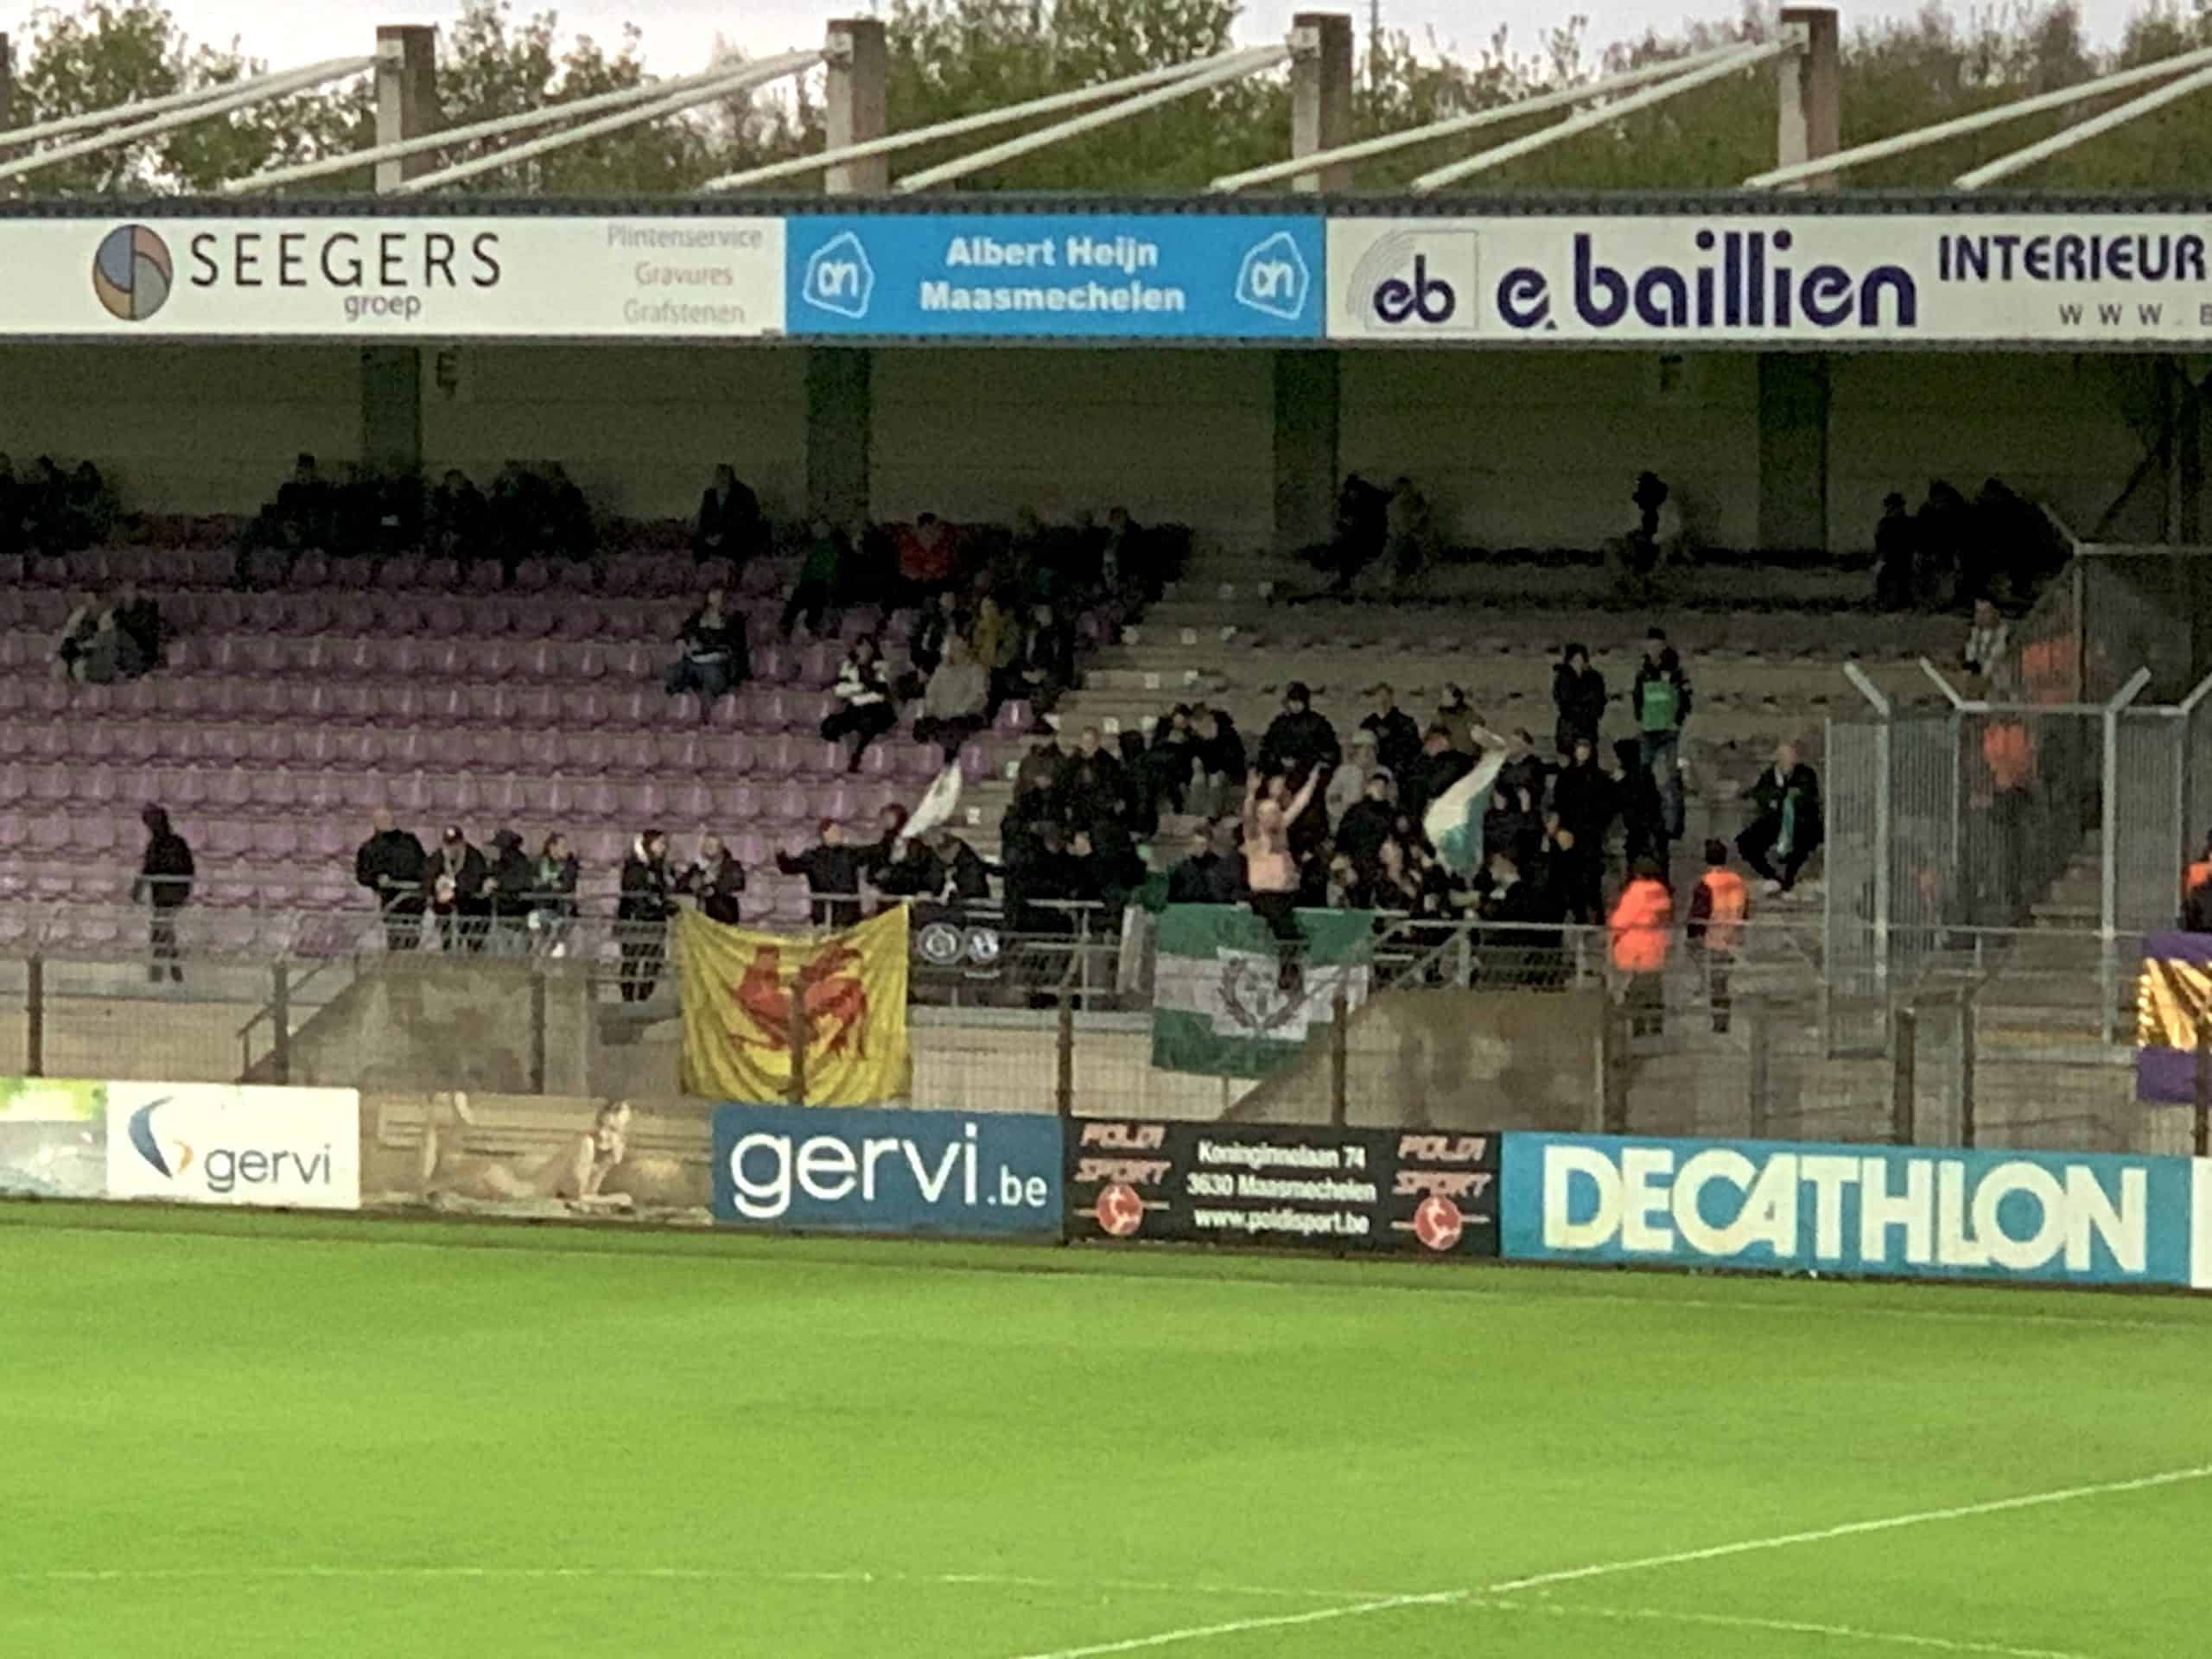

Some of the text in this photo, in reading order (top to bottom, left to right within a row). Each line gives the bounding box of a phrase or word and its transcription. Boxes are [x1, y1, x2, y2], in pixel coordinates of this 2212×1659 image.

[607, 224, 762, 250] Plintenservice
[189, 232, 501, 288] SEEGERS
[946, 236, 1158, 274] Albert Heijn
[1938, 234, 2206, 282] INTERIEUR
[634, 261, 734, 287] Gravures
[1373, 253, 1456, 324] eb
[344, 295, 423, 322] groep
[623, 298, 746, 325] Grafstenen
[919, 281, 1185, 313] Maasmechelen
[203, 1141, 332, 1194] gervi
[1074, 1158, 1172, 1185] SPORT
[1342, 1145, 1367, 1170] 74
[1185, 1172, 1377, 1203] 3630 Maasmechelen
[1392, 1170, 1492, 1198] SPORT
[1193, 1207, 1370, 1236] www.poldisport.be
[1542, 1144, 2148, 1274] DECATHLON
